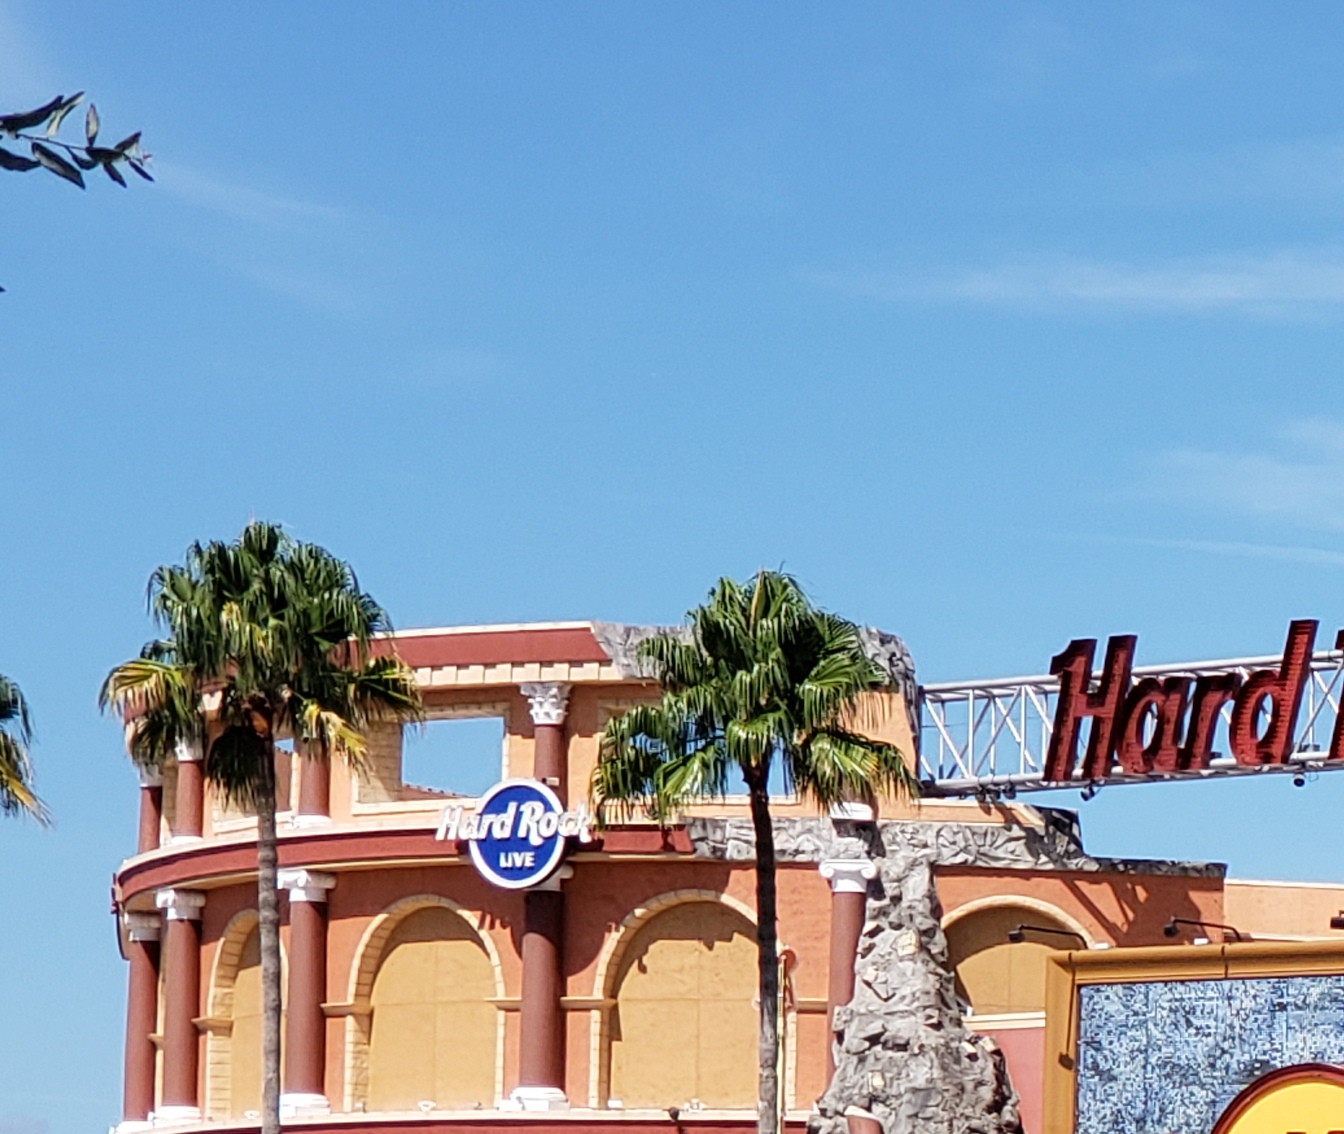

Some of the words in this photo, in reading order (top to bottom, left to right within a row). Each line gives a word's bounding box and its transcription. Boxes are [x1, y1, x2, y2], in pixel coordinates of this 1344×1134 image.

[1043, 618, 1320, 783] Hard
[435, 801, 518, 841] Hard
[517, 800, 594, 847] Rock
[499, 851, 536, 869] LIVE
